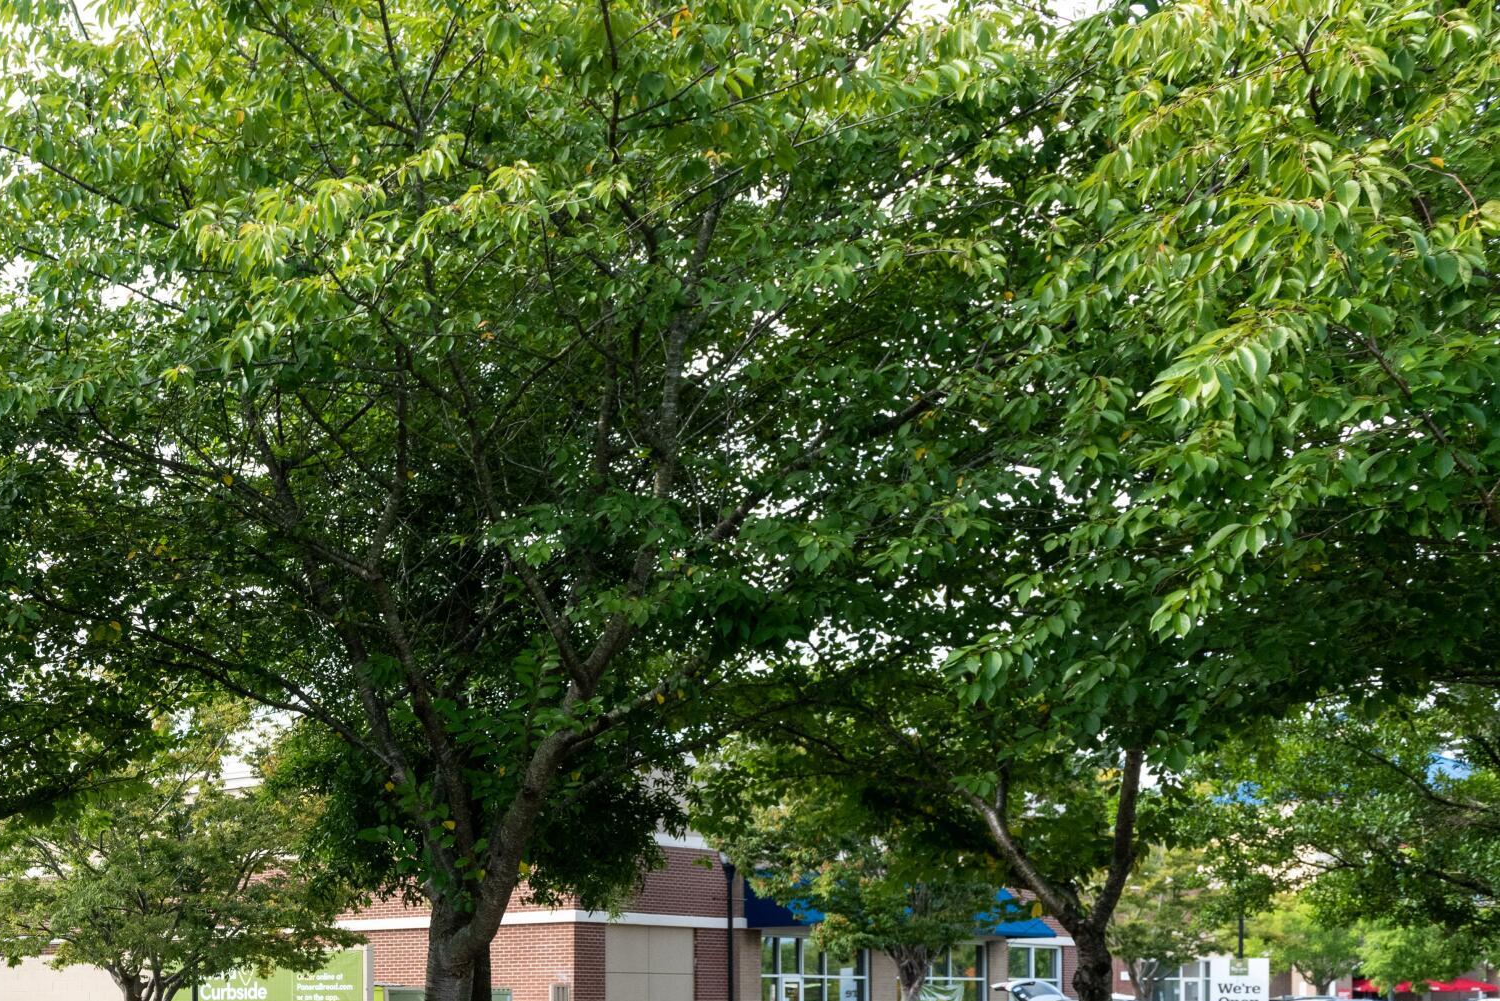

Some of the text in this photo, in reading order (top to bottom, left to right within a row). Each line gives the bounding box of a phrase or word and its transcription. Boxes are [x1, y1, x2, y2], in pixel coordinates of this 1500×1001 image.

[315, 972, 335, 981] online
[336, 972, 344, 981] at
[200, 981, 268, 1000] Curbside
[1218, 983, 1261, 994] We're
[313, 993, 324, 1001] the
